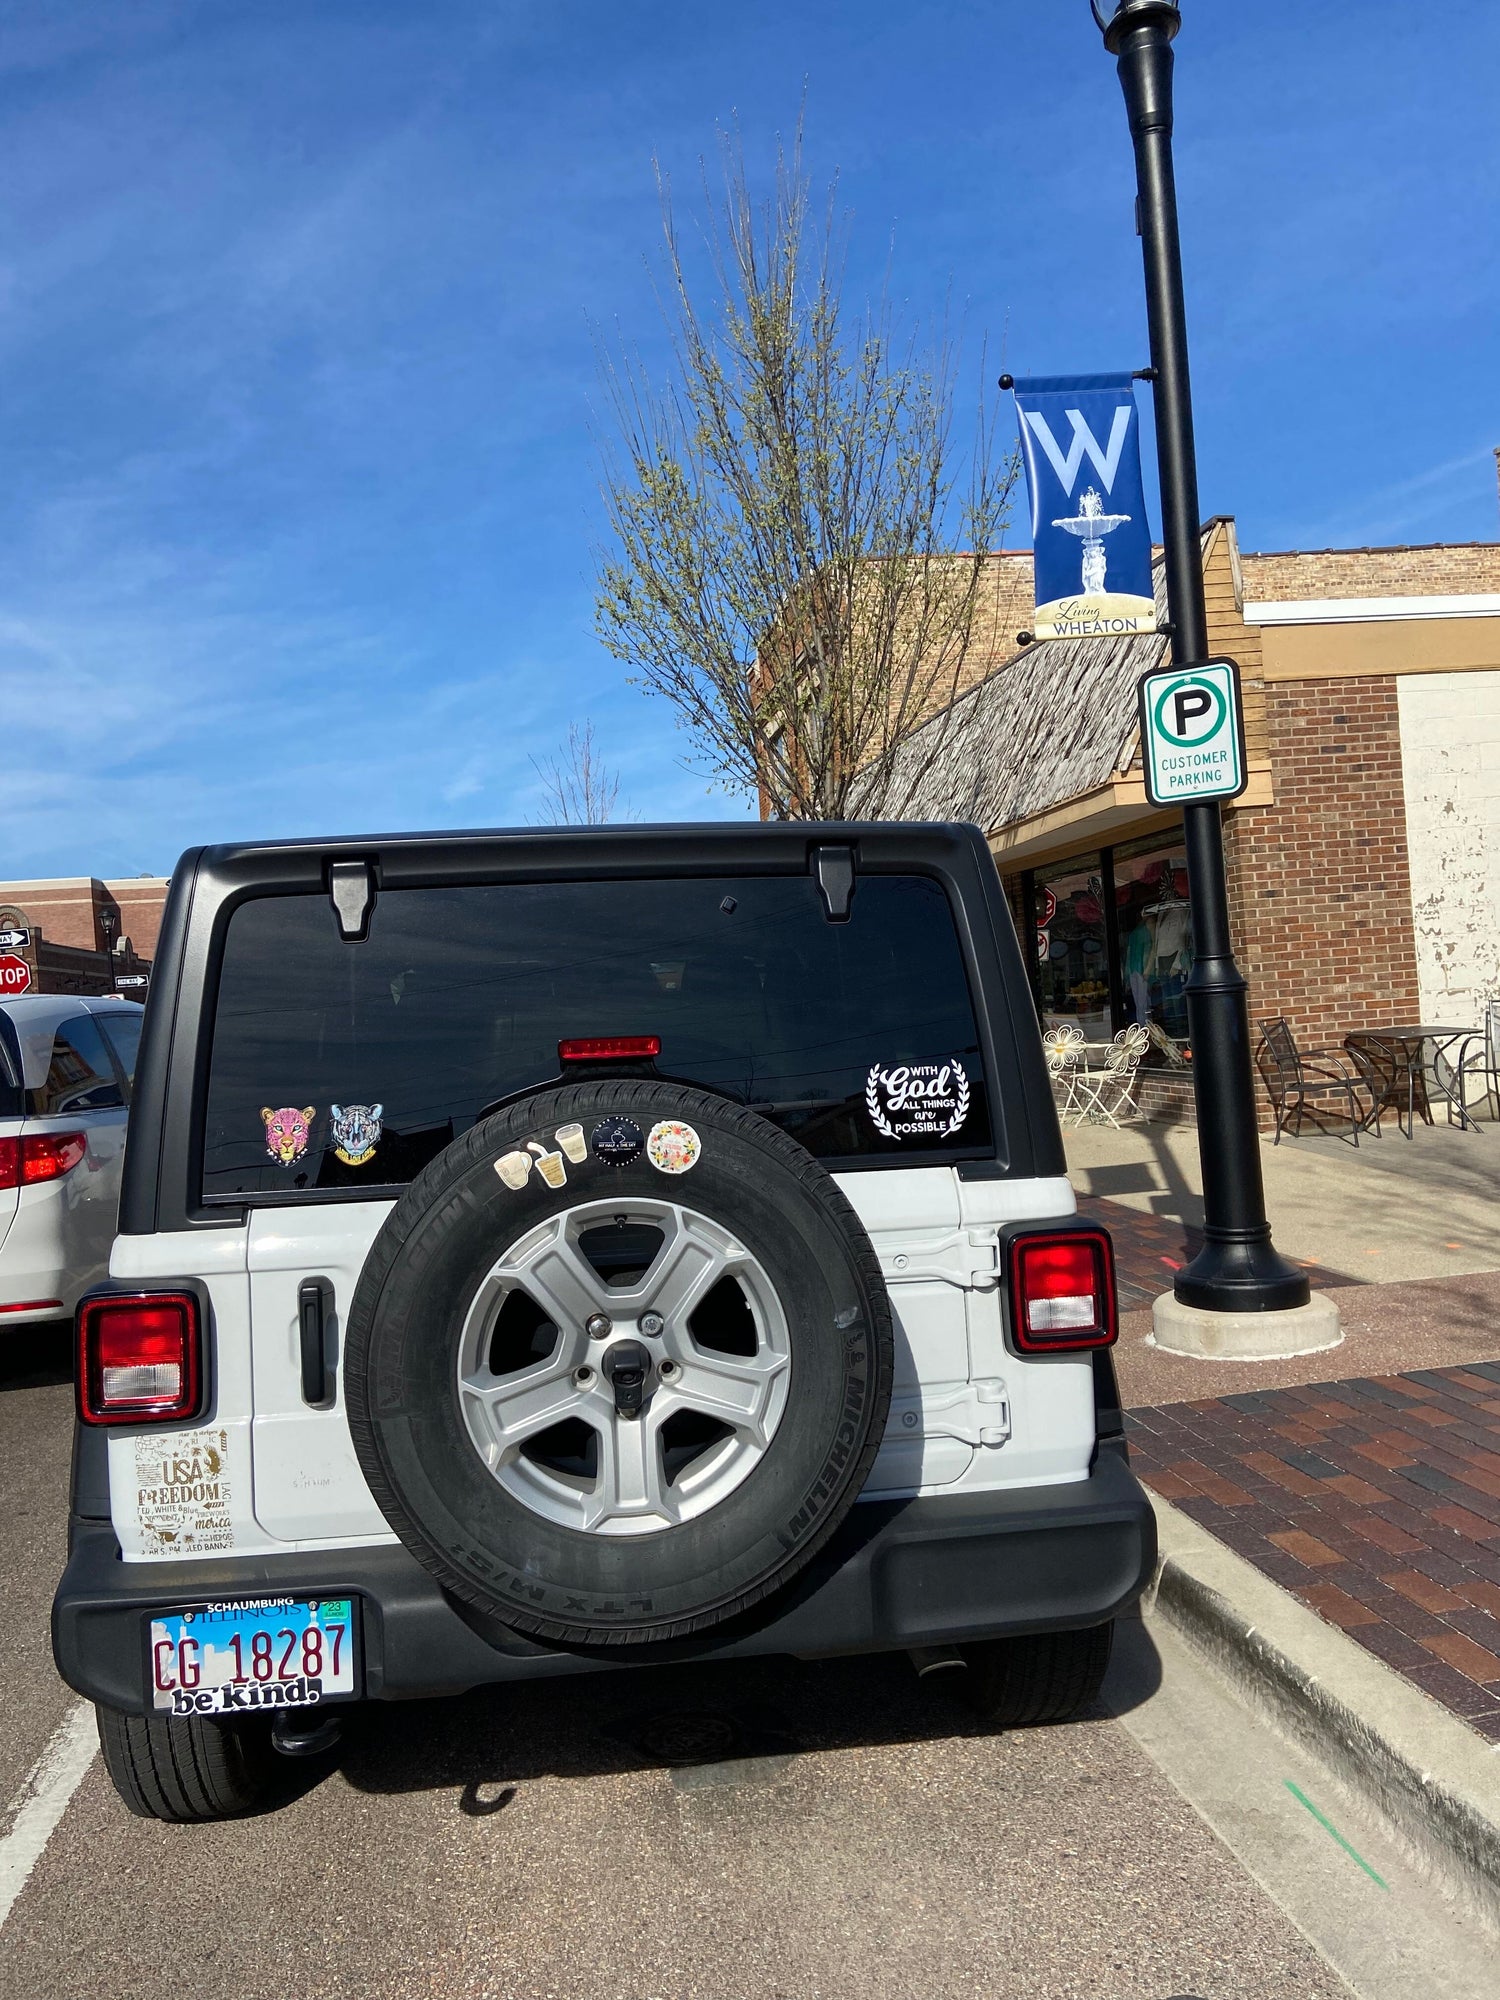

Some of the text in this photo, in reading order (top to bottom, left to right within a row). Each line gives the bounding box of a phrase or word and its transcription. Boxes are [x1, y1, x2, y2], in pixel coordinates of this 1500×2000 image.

[1024, 405, 1132, 497] W
[1055, 601, 1100, 622] Living
[1053, 618, 1138, 635] WHEATON
[1174, 689, 1212, 736] P
[1161, 750, 1228, 771] CUSTOMER
[1169, 769, 1222, 788] PARKING
[910, 1066, 938, 1076] WITH
[880, 1066, 951, 1111] God
[903, 1099, 956, 1110] ALL THINGS
[914, 1111, 936, 1121] are
[895, 1121, 947, 1134] POSSIBLE
[788, 1375, 865, 1540] MICHELIN
[163, 1459, 203, 1486] USA
[138, 1483, 219, 1506] FREEDOM
[154, 1505, 177, 1513] WHITE
[208, 1597, 294, 1613] SCHAUMBURG
[328, 1602, 341, 1611] 23
[563, 1595, 653, 1614] LTX
[154, 1625, 345, 1691] CG 18287
[172, 1677, 319, 1714] be kind.
